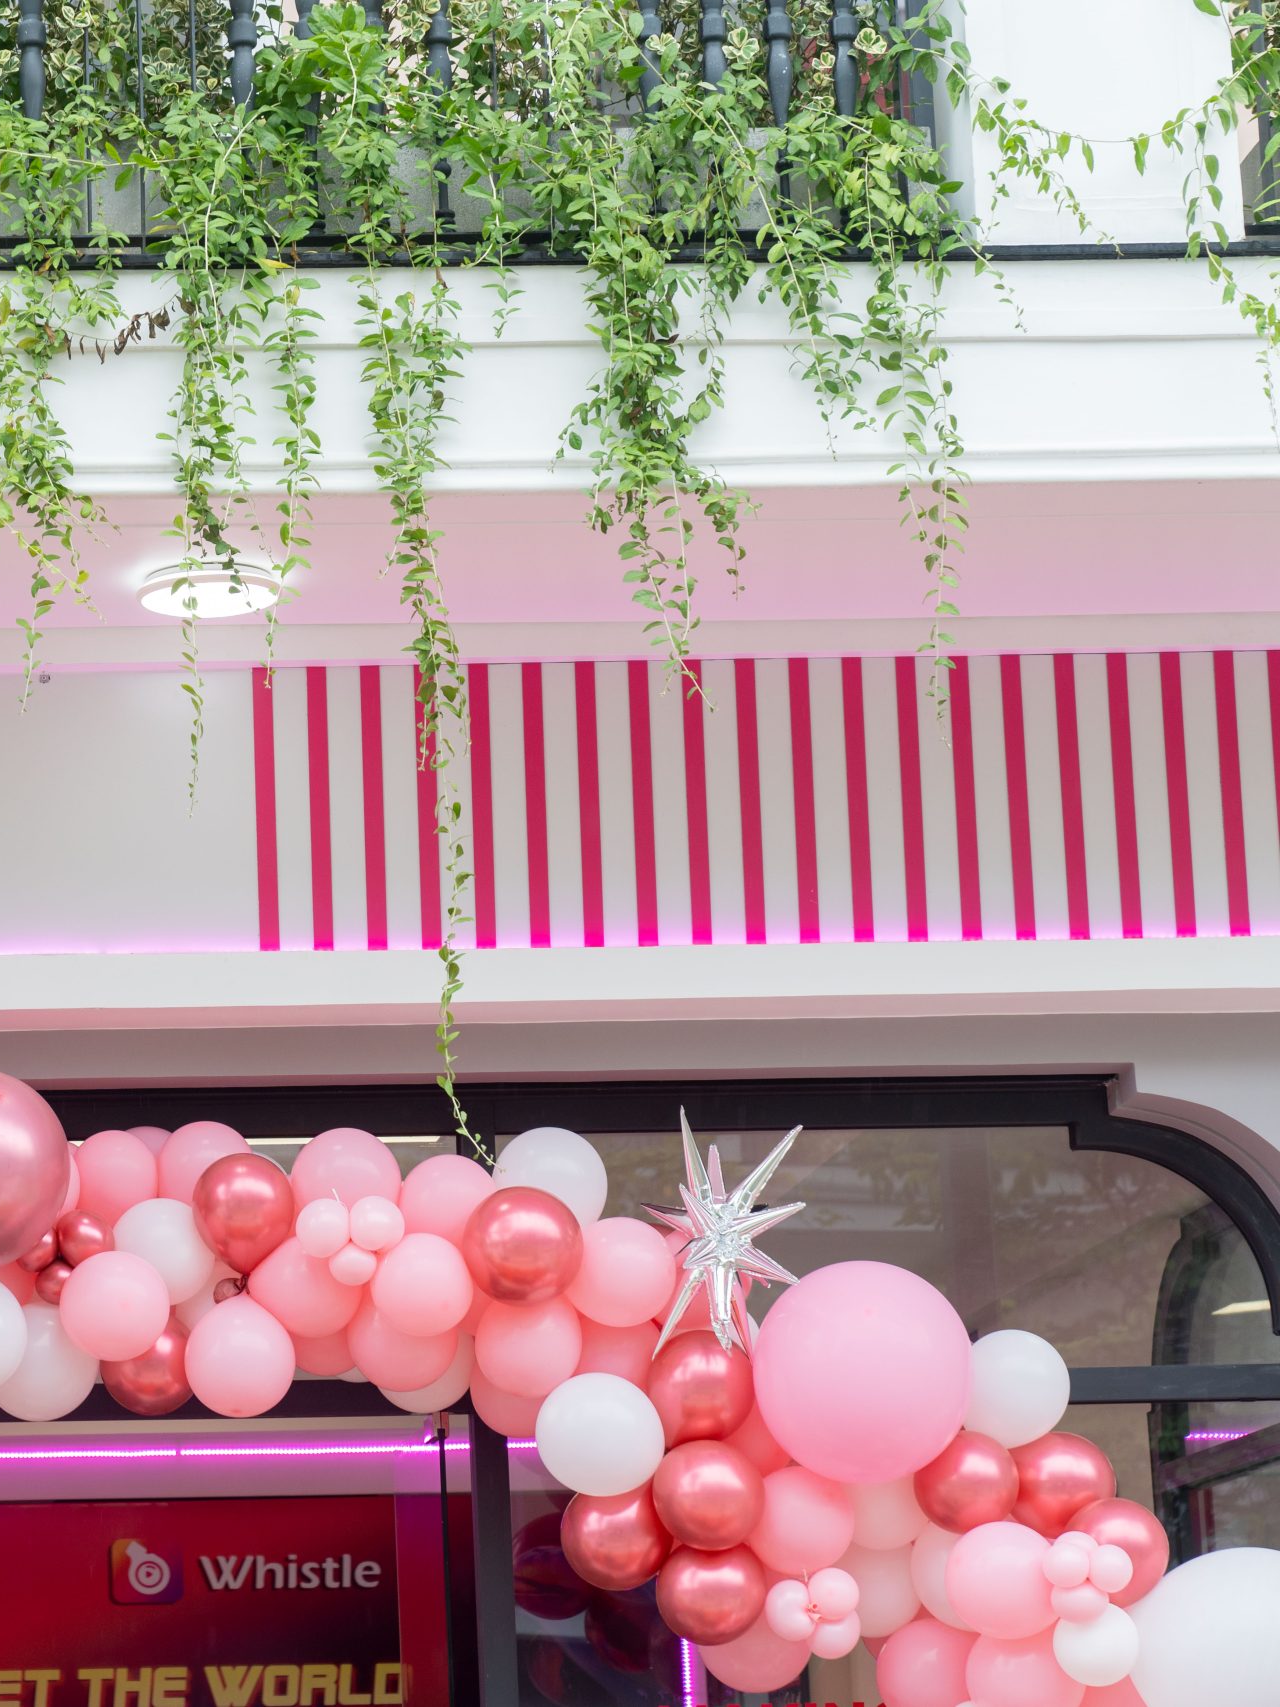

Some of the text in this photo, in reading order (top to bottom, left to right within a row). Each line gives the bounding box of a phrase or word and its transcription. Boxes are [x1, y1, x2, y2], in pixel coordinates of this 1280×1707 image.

[200, 1554, 382, 1590] Whistle
[78, 1667, 188, 1707] THE
[204, 1663, 412, 1706] WORLD
